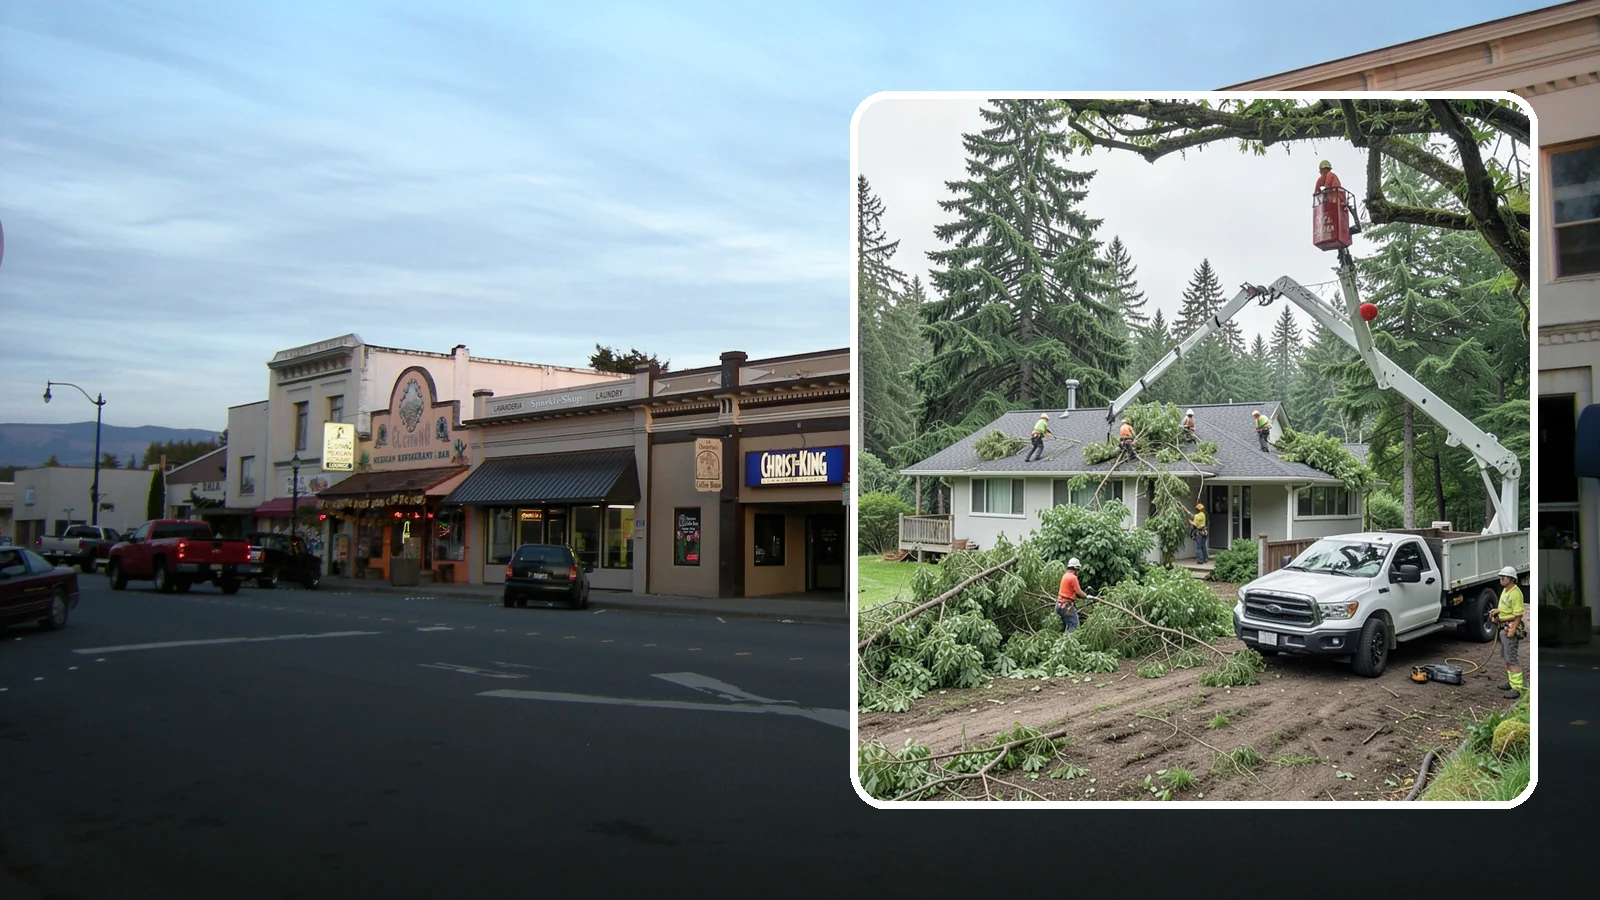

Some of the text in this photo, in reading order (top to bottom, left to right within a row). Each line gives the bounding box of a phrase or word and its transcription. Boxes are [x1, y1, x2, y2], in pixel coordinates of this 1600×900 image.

[561, 395, 582, 405] Shop
[595, 389, 623, 400] LAUNDRY
[493, 402, 522, 413] LAVANDERIA
[373, 450, 450, 464] MEXICAN RESTAURANT BAR
[761, 450, 827, 477] CHRIST KING
